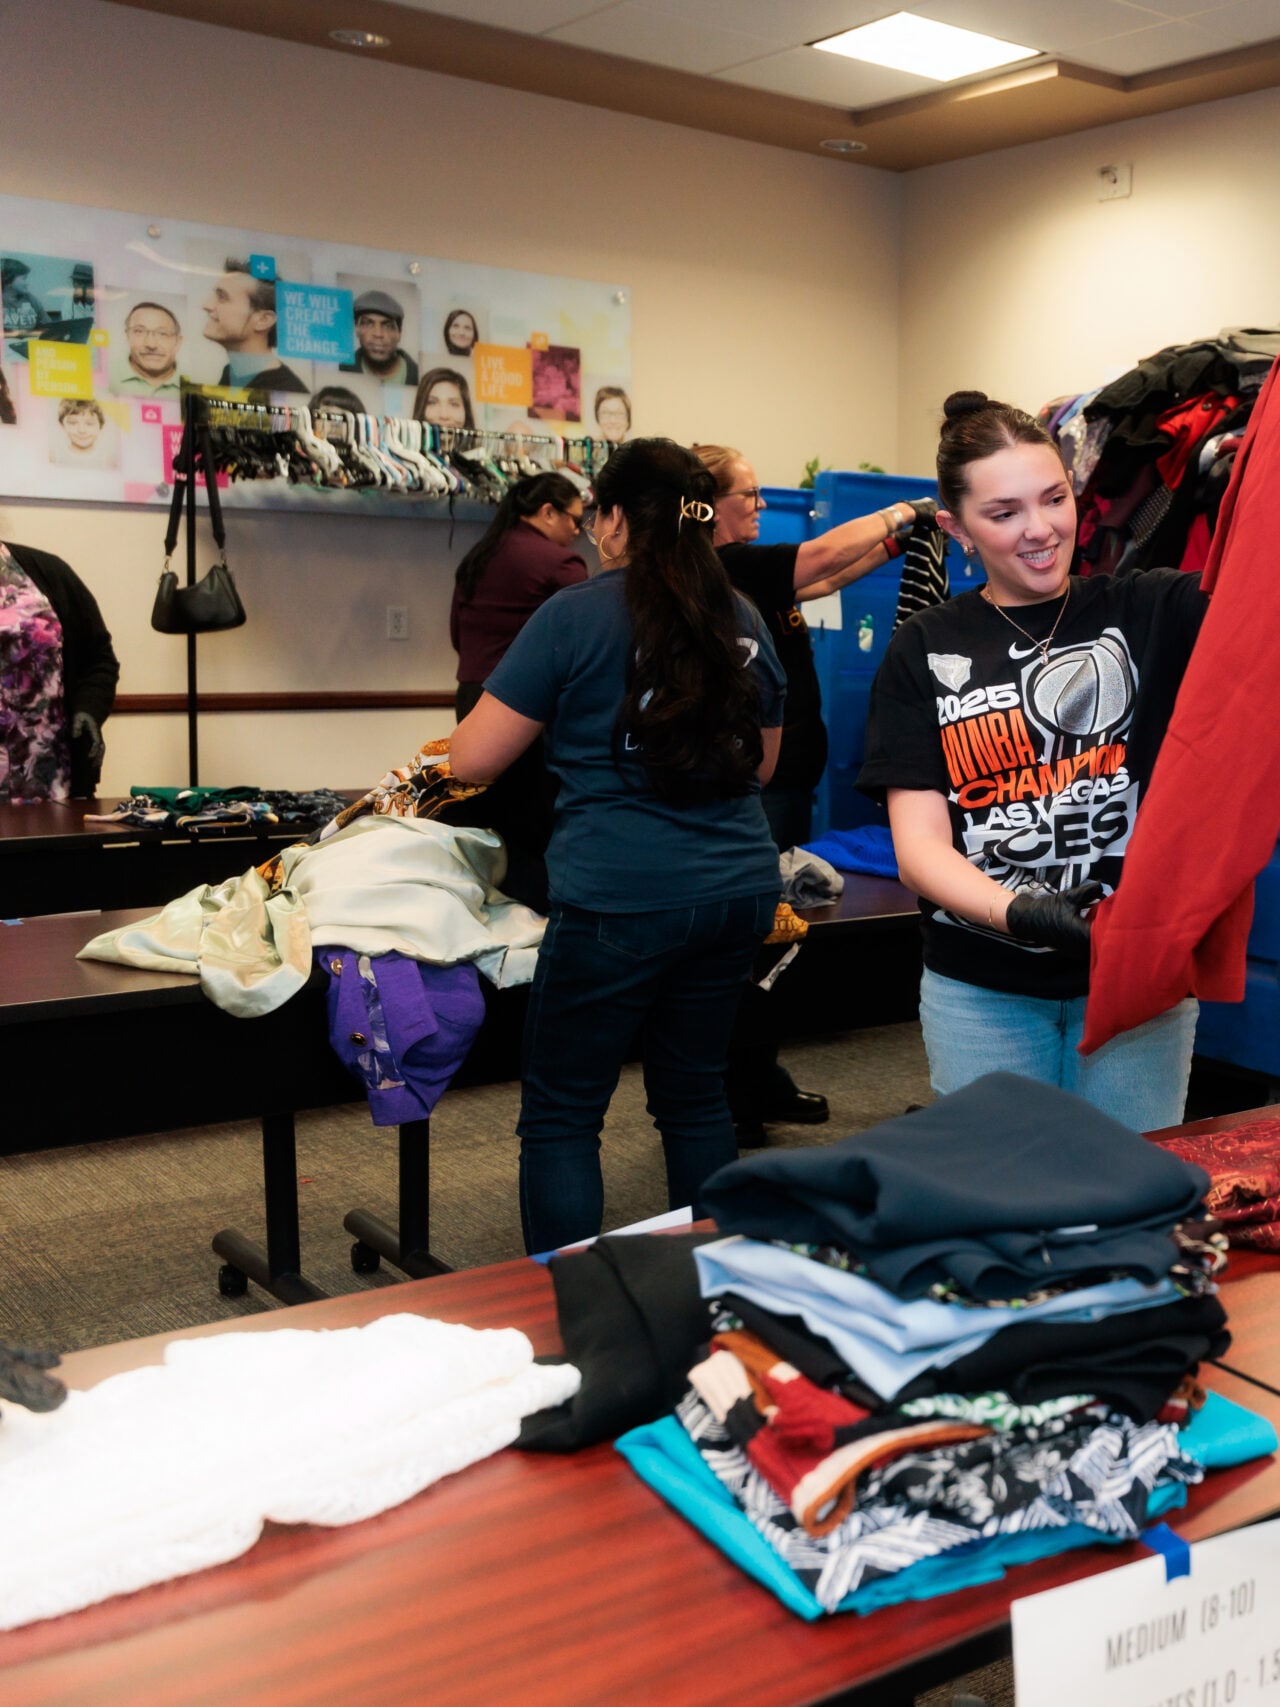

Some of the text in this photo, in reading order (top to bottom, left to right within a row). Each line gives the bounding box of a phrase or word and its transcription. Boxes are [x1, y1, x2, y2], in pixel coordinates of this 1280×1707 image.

[284, 291, 340, 311] WE WILL
[285, 306, 335, 326] CREATE
[286, 321, 310, 337] THE
[936, 682, 1021, 727] 2025
[940, 708, 1036, 788] WNBA
[957, 743, 1127, 809] CHAMPION
[963, 766, 1131, 831] LAS VEGAS
[1105, 1578, 1256, 1672] MEDIUM (8-10)
